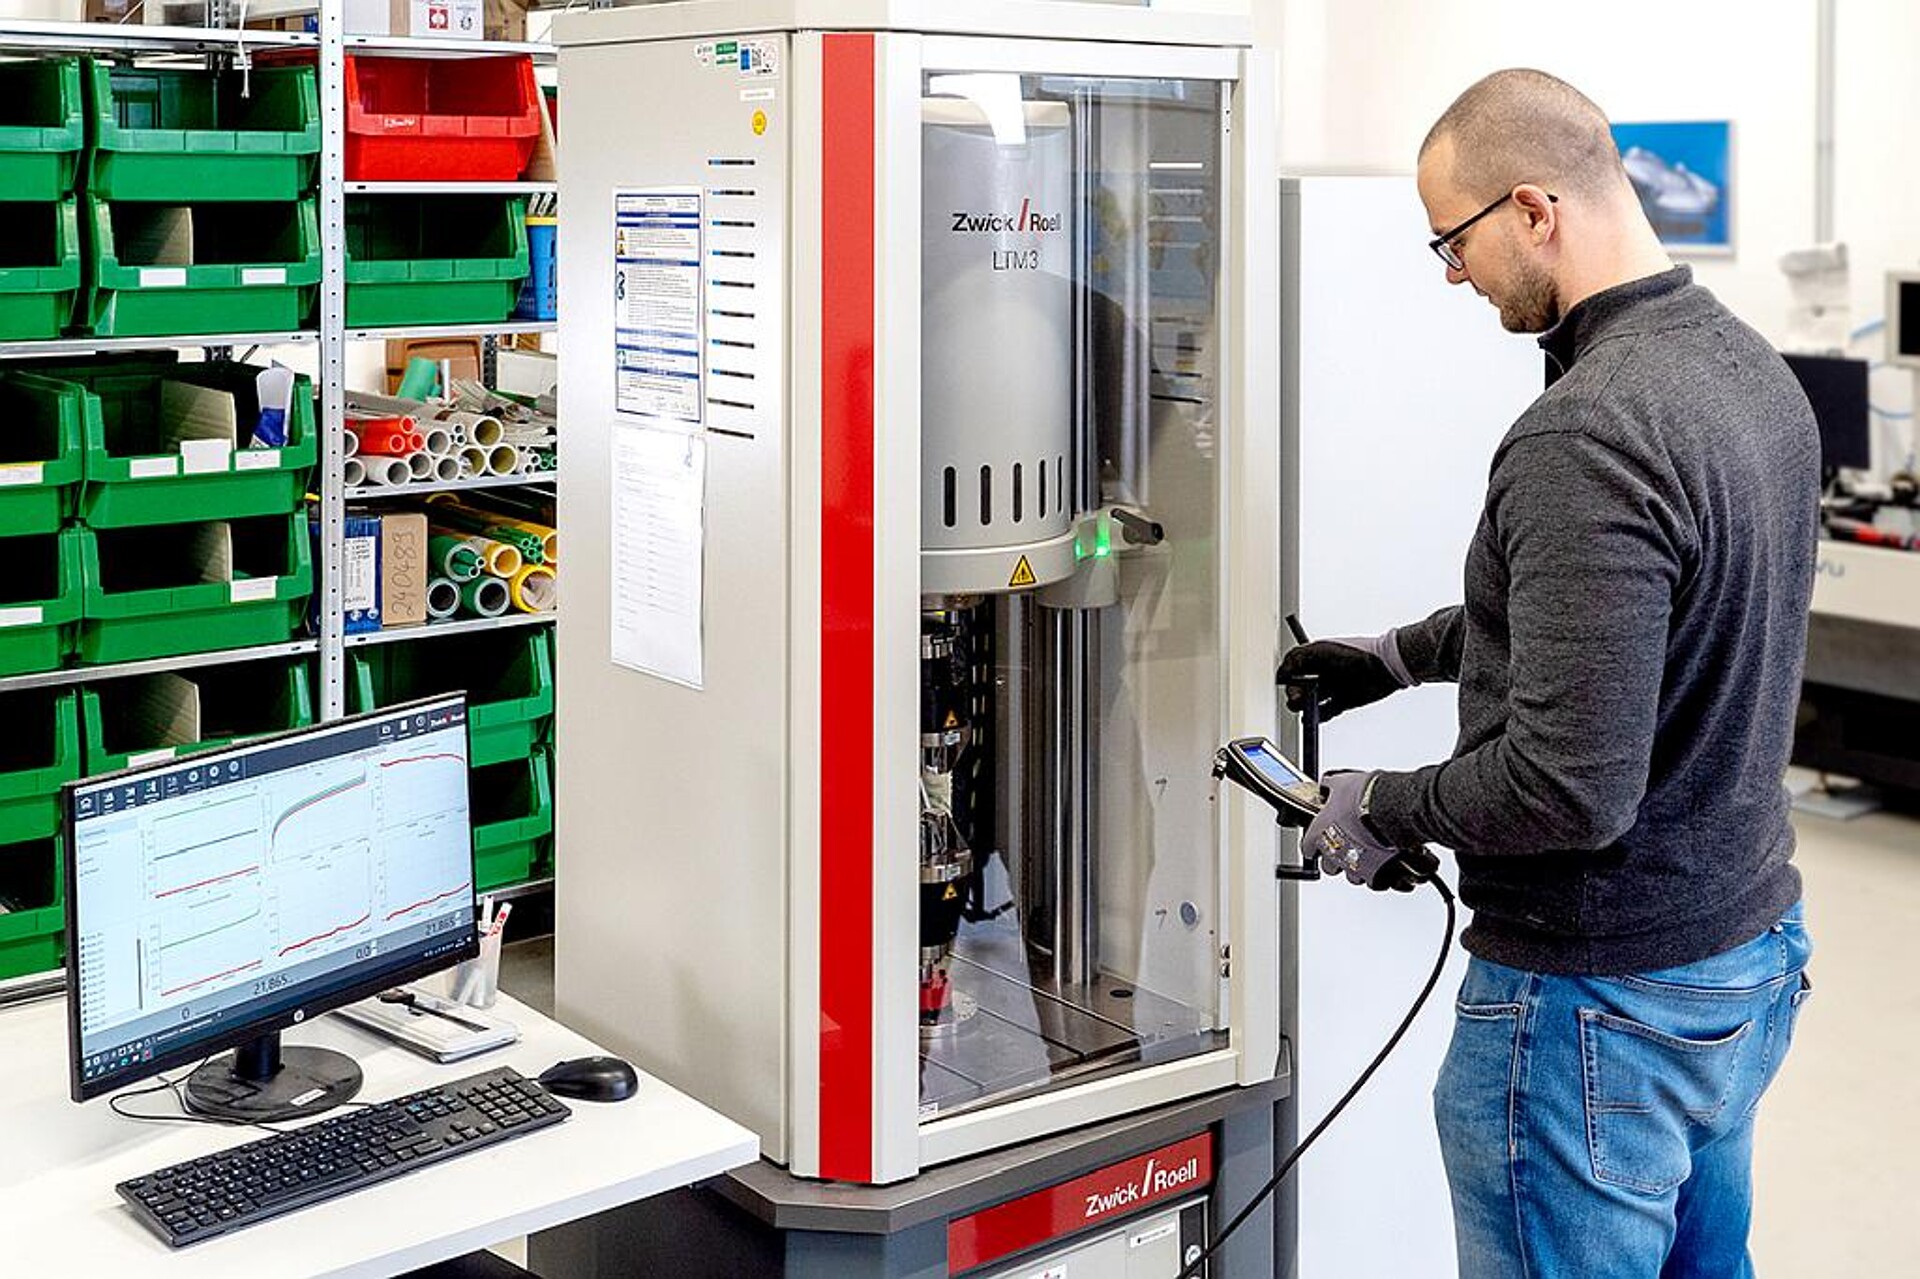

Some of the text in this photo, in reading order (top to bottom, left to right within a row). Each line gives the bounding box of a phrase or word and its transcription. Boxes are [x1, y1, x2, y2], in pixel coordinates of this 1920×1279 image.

[951, 212, 1014, 232] Zwick
[992, 250, 1039, 270] LTM3
[1085, 1158, 1197, 1217] Zwick Roell
